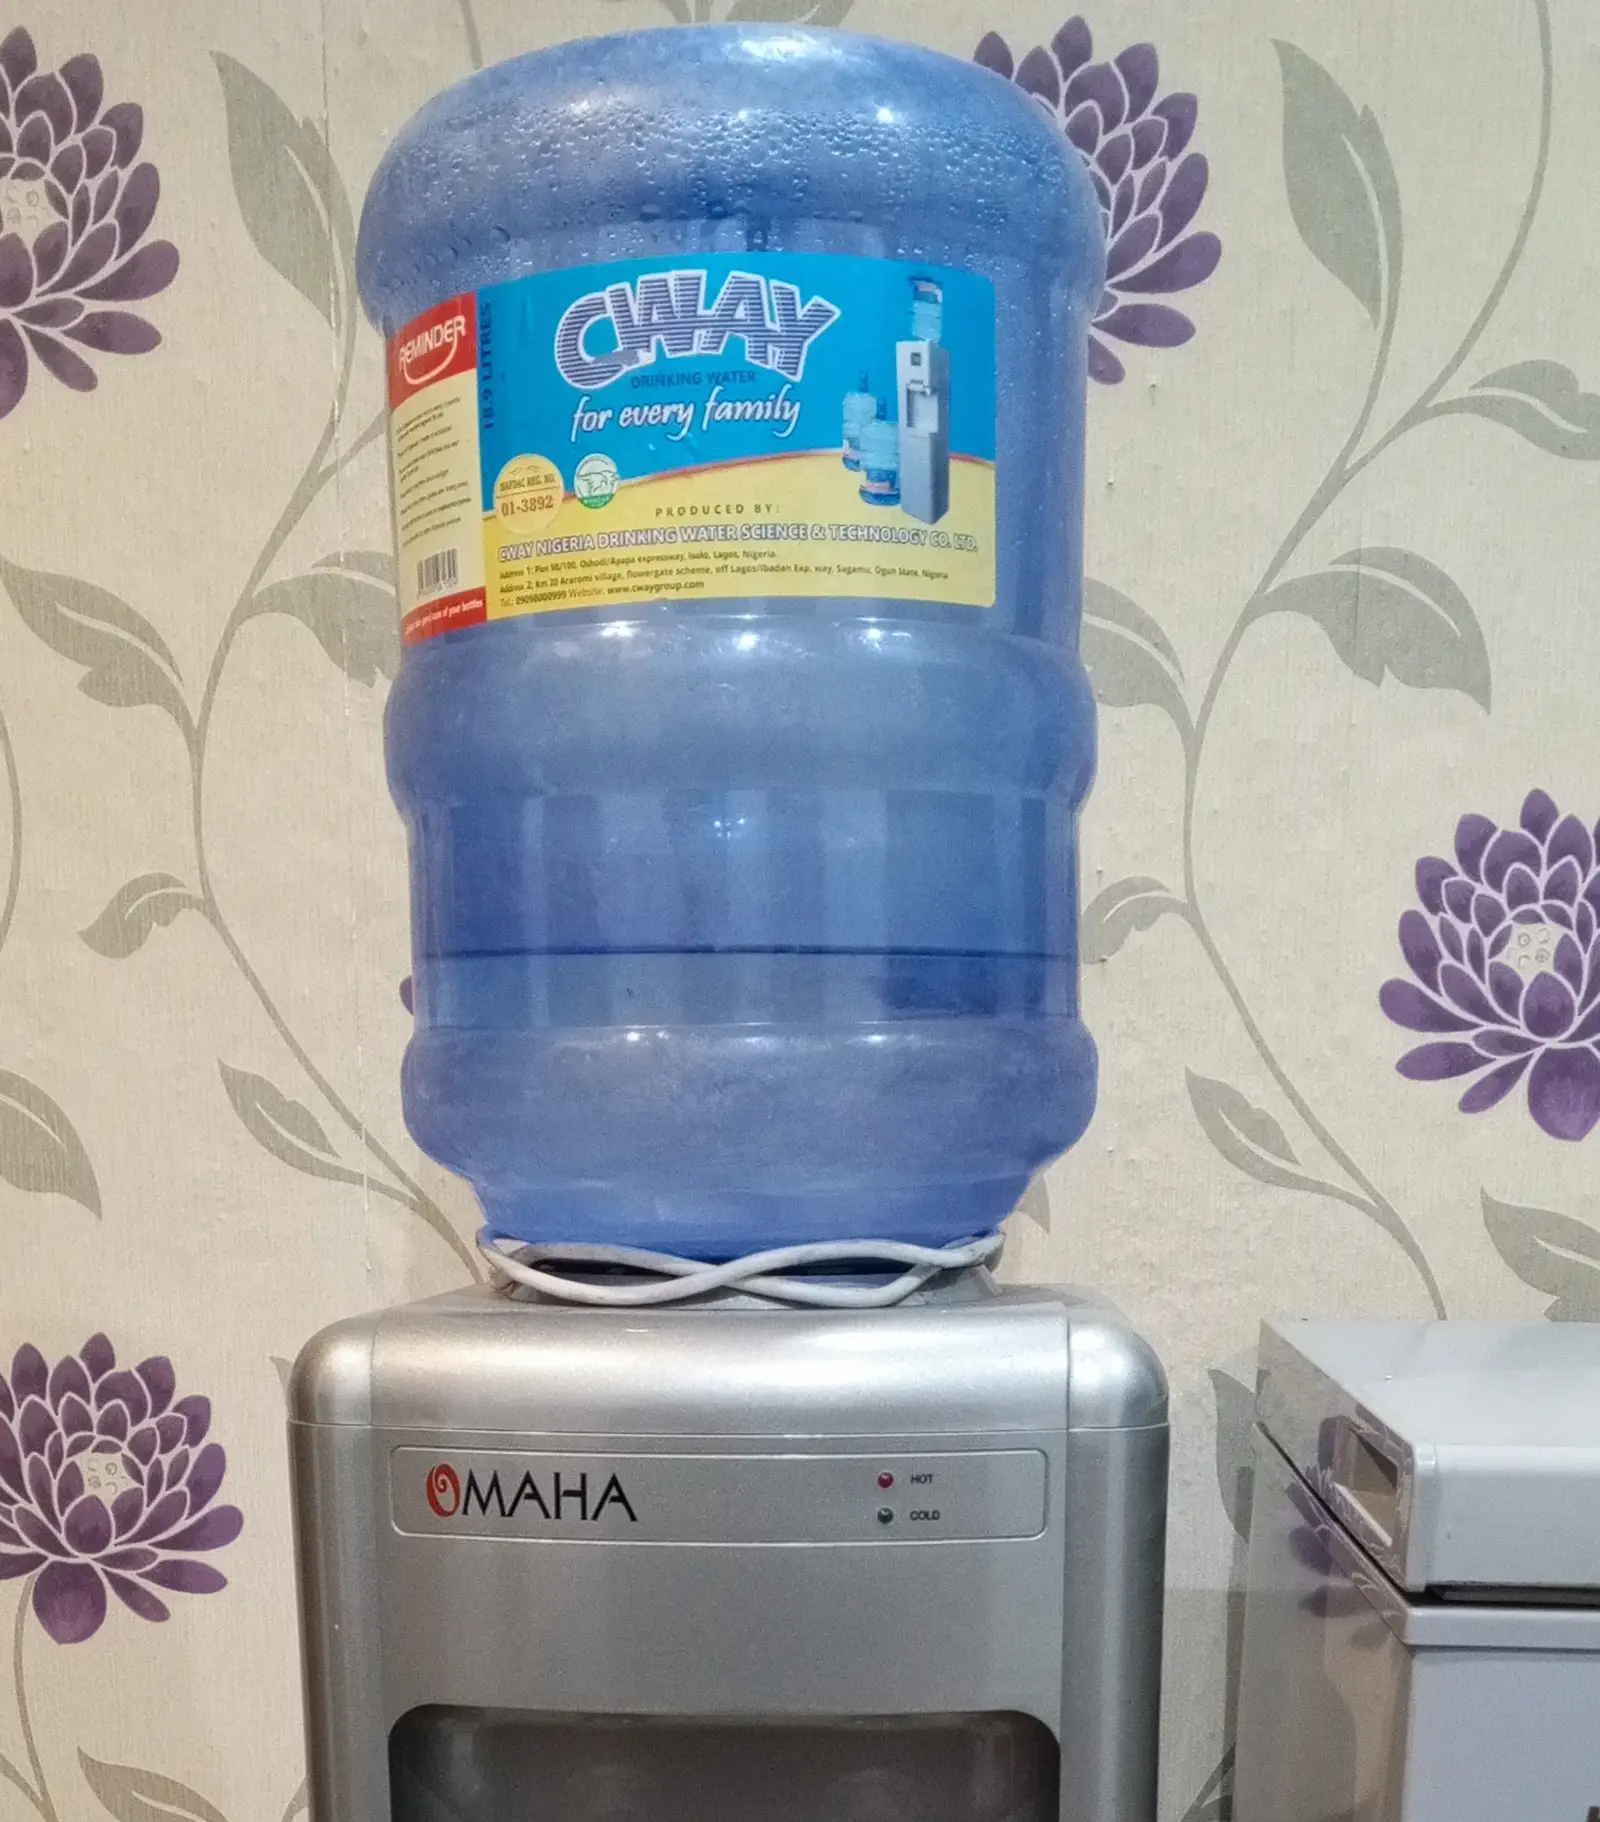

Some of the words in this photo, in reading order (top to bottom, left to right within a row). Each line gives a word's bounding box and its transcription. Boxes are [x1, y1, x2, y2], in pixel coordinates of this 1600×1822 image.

[555, 269, 841, 389] CWAY
[399, 315, 466, 385] REMINDER
[480, 301, 493, 381] LITRES
[631, 371, 702, 389] DRINKING
[708, 369, 757, 385] WATER
[571, 396, 613, 443] for
[618, 400, 695, 442] every
[702, 384, 802, 439] family
[501, 495, 554, 516] 01-3892
[655, 503, 744, 517] PRODUCED
[754, 503, 780, 514] BY:
[499, 544, 533, 563] CWAY
[535, 533, 594, 557] NIGERIA
[597, 526, 677, 551] DRINKING
[679, 523, 739, 543] WATER
[740, 523, 809, 541] SCIENCE
[811, 524, 826, 540] &
[828, 524, 928, 548] TECHNOLOGY
[930, 530, 951, 549] CO.
[953, 533, 979, 552] LTD.
[626, 568, 673, 580] flowergate
[716, 563, 728, 573] off
[730, 563, 792, 574] Lagos/Ibadan
[607, 580, 704, 594] www.cwaygroup.com
[910, 1474, 934, 1484] HOT
[427, 1463, 637, 1522] OMAHA
[910, 1510, 941, 1521] COLD
